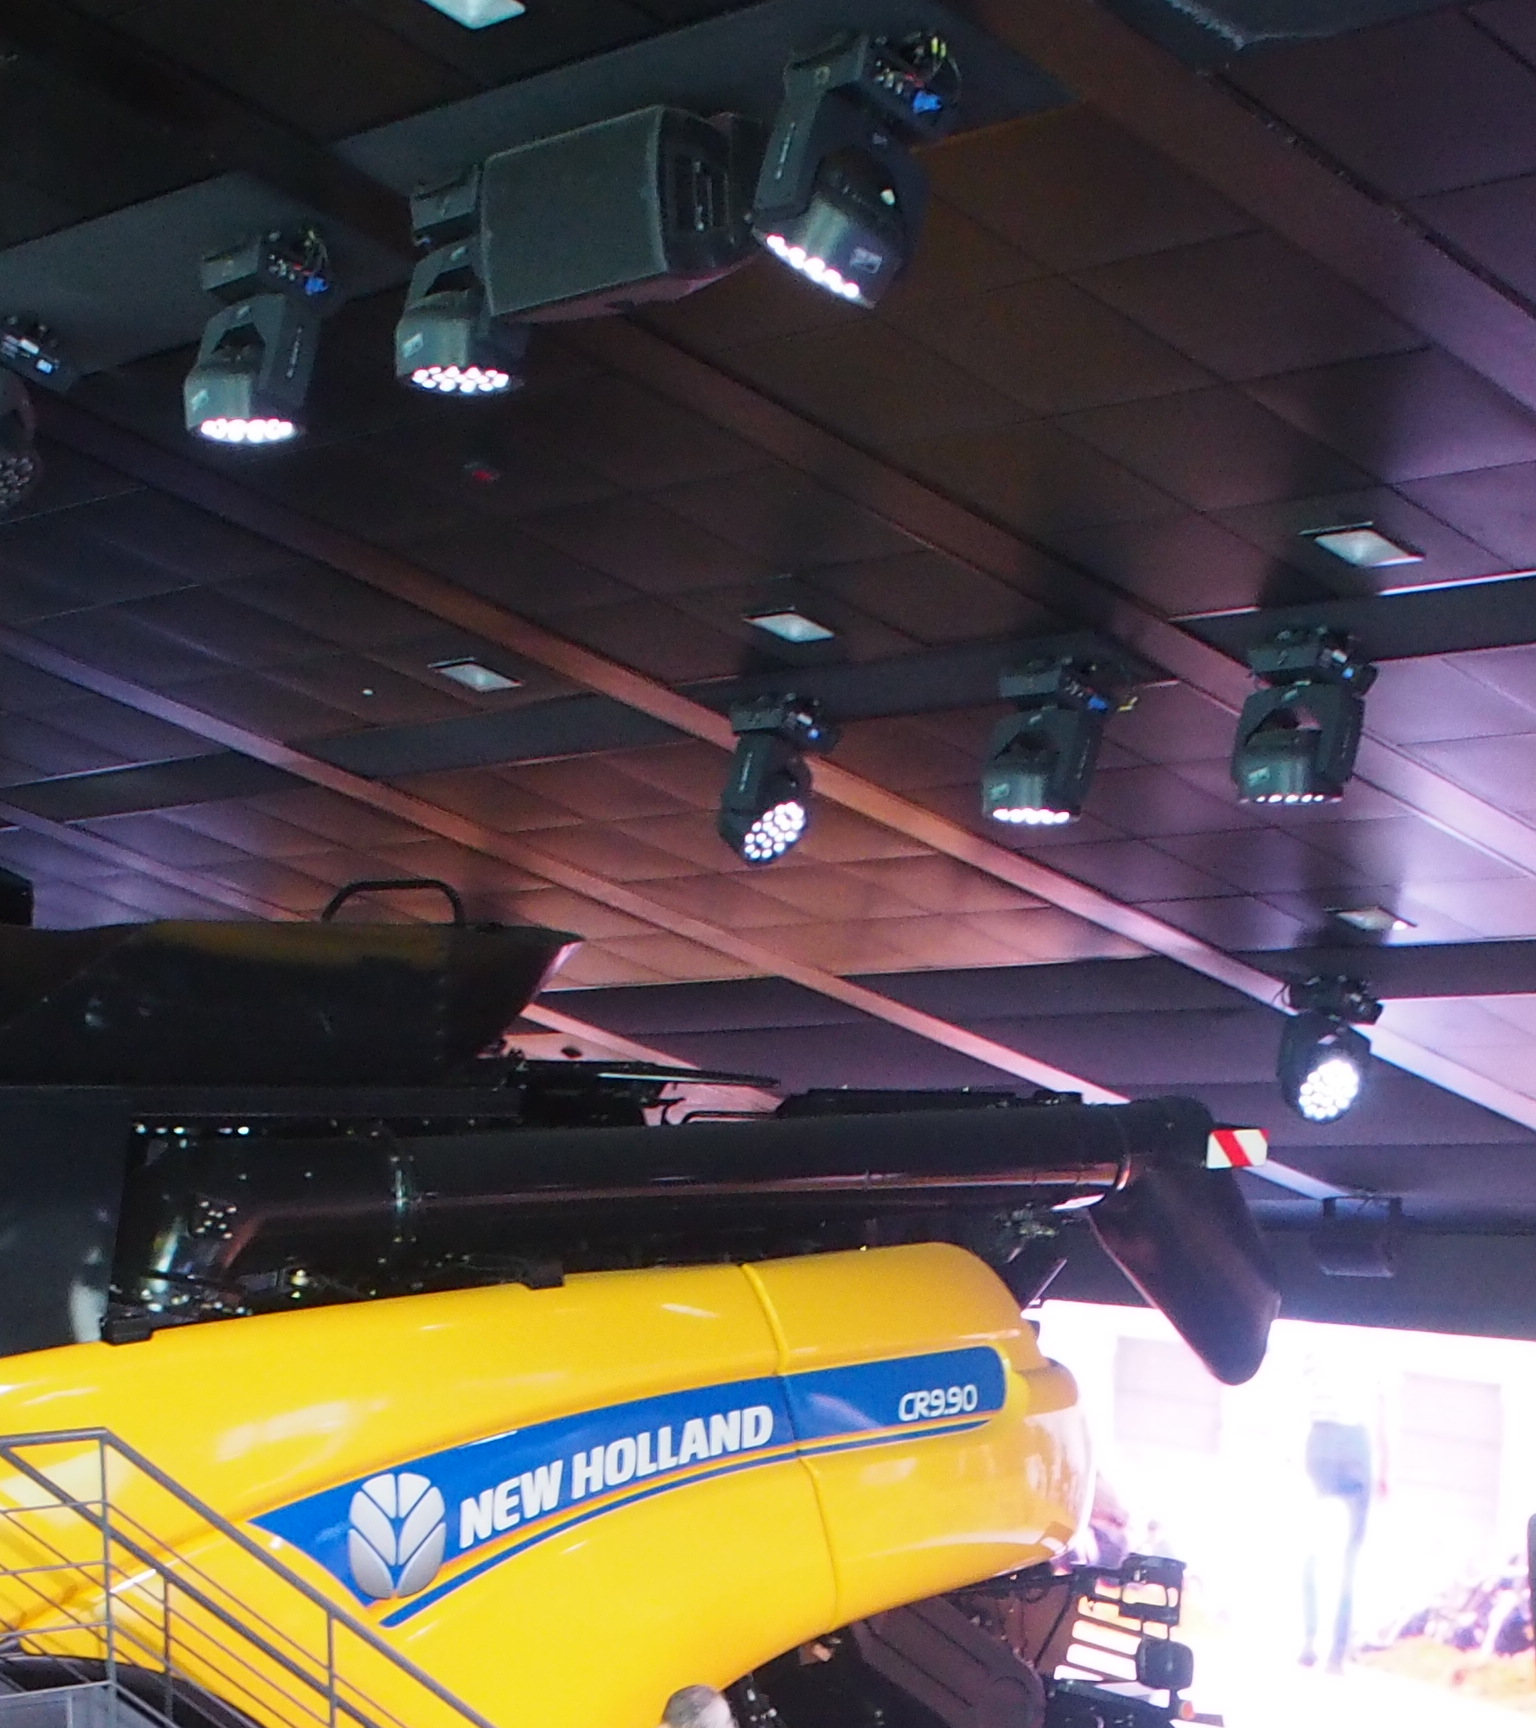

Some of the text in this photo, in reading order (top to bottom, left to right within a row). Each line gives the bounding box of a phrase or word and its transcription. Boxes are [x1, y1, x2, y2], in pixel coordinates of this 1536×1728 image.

[898, 1383, 979, 1422] CR9.90
[459, 1404, 774, 1550] NEW HOLLAND
